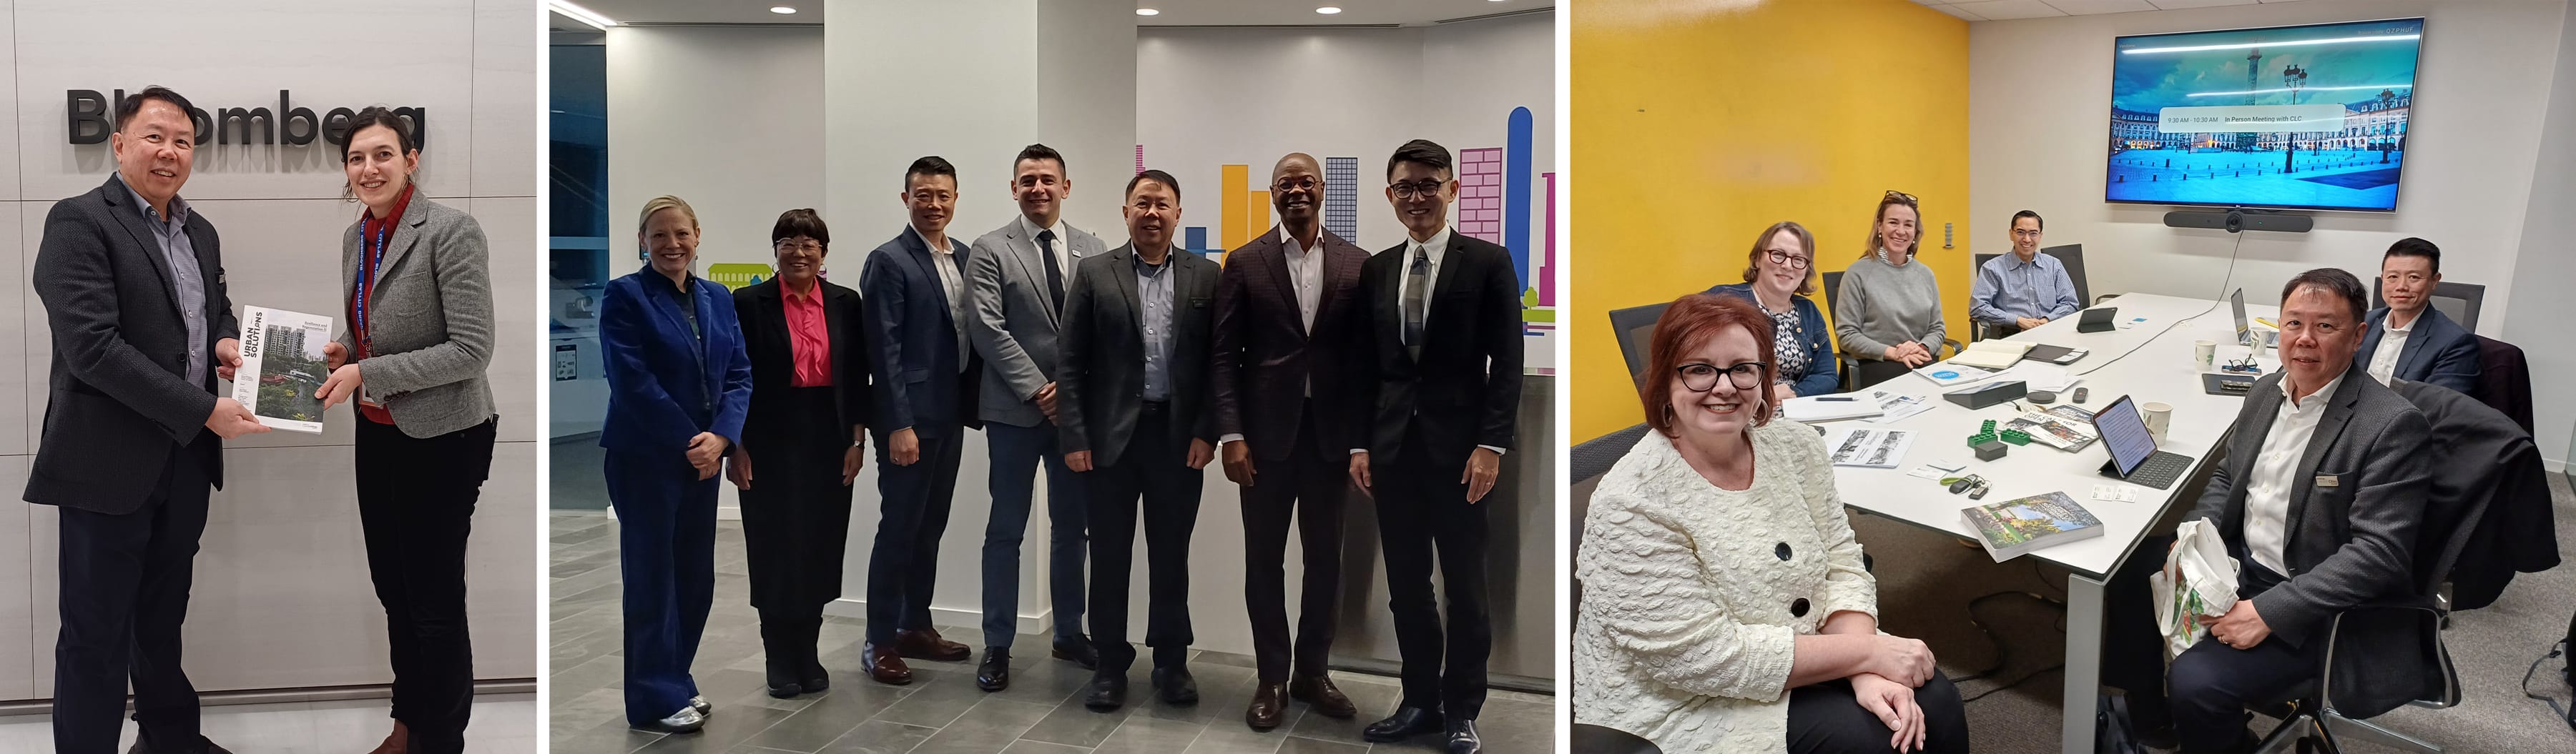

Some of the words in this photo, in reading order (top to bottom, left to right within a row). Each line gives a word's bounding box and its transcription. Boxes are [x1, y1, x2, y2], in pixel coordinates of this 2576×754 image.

[67, 89, 426, 154] Blombeg
[244, 327, 254, 357] URBAN
[250, 311, 262, 358] SOLUTIONS
